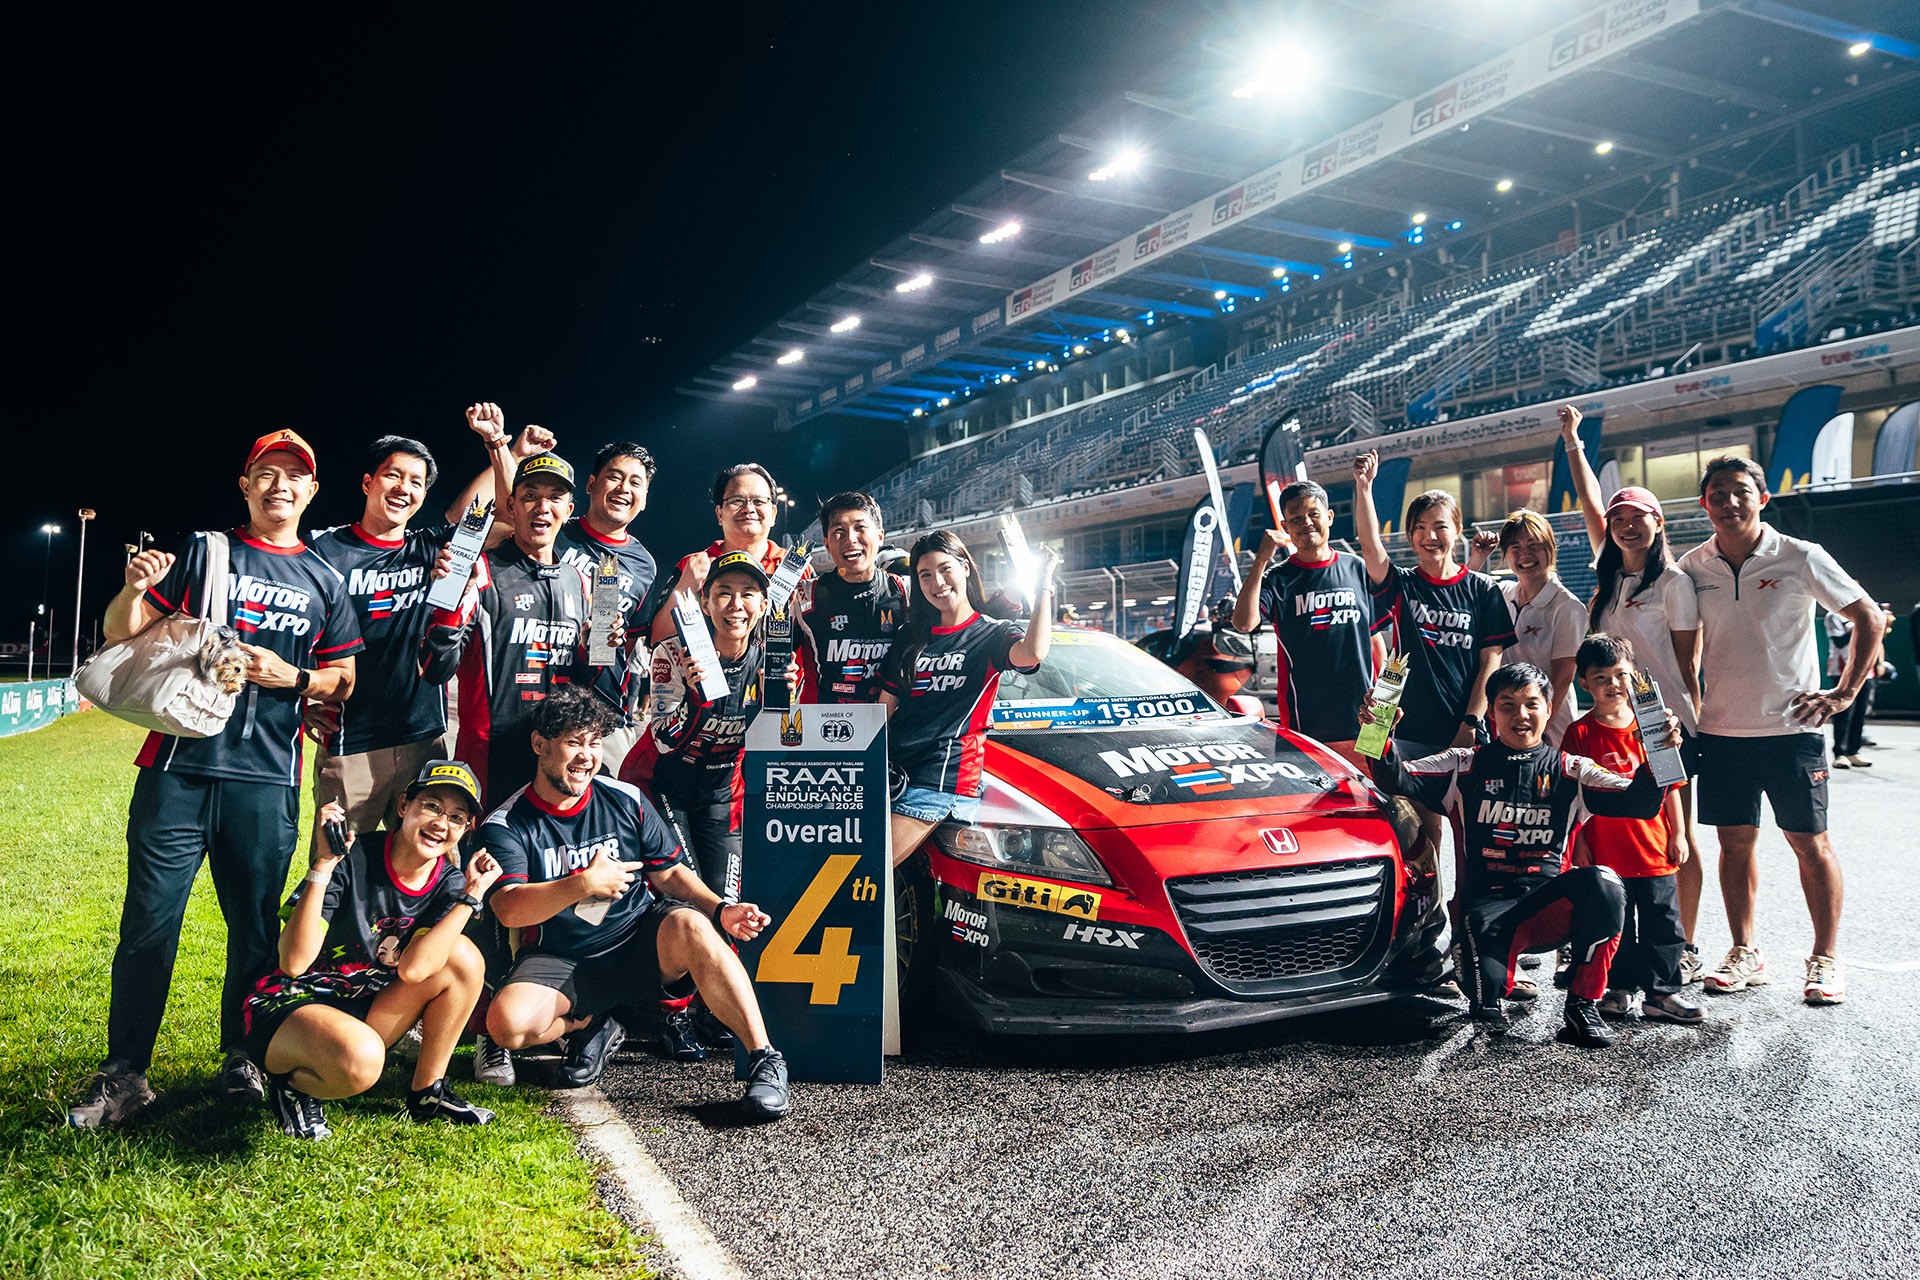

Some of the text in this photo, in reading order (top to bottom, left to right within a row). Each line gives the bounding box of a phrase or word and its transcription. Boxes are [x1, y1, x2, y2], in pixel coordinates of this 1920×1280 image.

[1551, 29, 1601, 67] GR
[1412, 99, 1455, 133] GR
[1340, 134, 1378, 156] GAZOO
[1343, 122, 1383, 145] TOYOTA
[1248, 171, 1282, 188] TOYOTA
[1303, 157, 1336, 183] GR
[1246, 182, 1278, 201] GAZOO
[1163, 213, 1193, 230] TOYOTA
[1213, 200, 1242, 224] GR
[1162, 222, 1189, 239] GAZOO
[1135, 237, 1160, 259] GR
[1071, 270, 1091, 290] GR
[1012, 299, 1031, 316] GR
[228, 573, 310, 612] MOTOR
[348, 566, 424, 596] MOTOR
[770, 578, 793, 593] OVERALL
[1296, 591, 1356, 616] MOTOR
[1410, 599, 1471, 630] MOTOR
[234, 600, 311, 636] EXPO
[510, 618, 576, 646] MOTOR
[916, 653, 966, 672] OTOR
[1170, 691, 1199, 699] CIRCUIT
[1014, 709, 1090, 719] RUNNER-UP
[1096, 699, 1195, 719] 15,000
[1097, 743, 1267, 779] MOTOR
[766, 768, 864, 785] RAAT
[1170, 762, 1302, 796] EXPO
[766, 792, 864, 802] ENDURANCE
[766, 802, 864, 810] CHAMPIONSHIP 2026
[1477, 800, 1551, 826] MOTOR
[766, 817, 863, 843] Overall
[1492, 823, 1554, 847] EXPO
[983, 880, 1052, 908] Giti
[944, 900, 988, 930] MOTOR
[951, 922, 990, 948] EXPO
[1063, 923, 1146, 950] HRX
